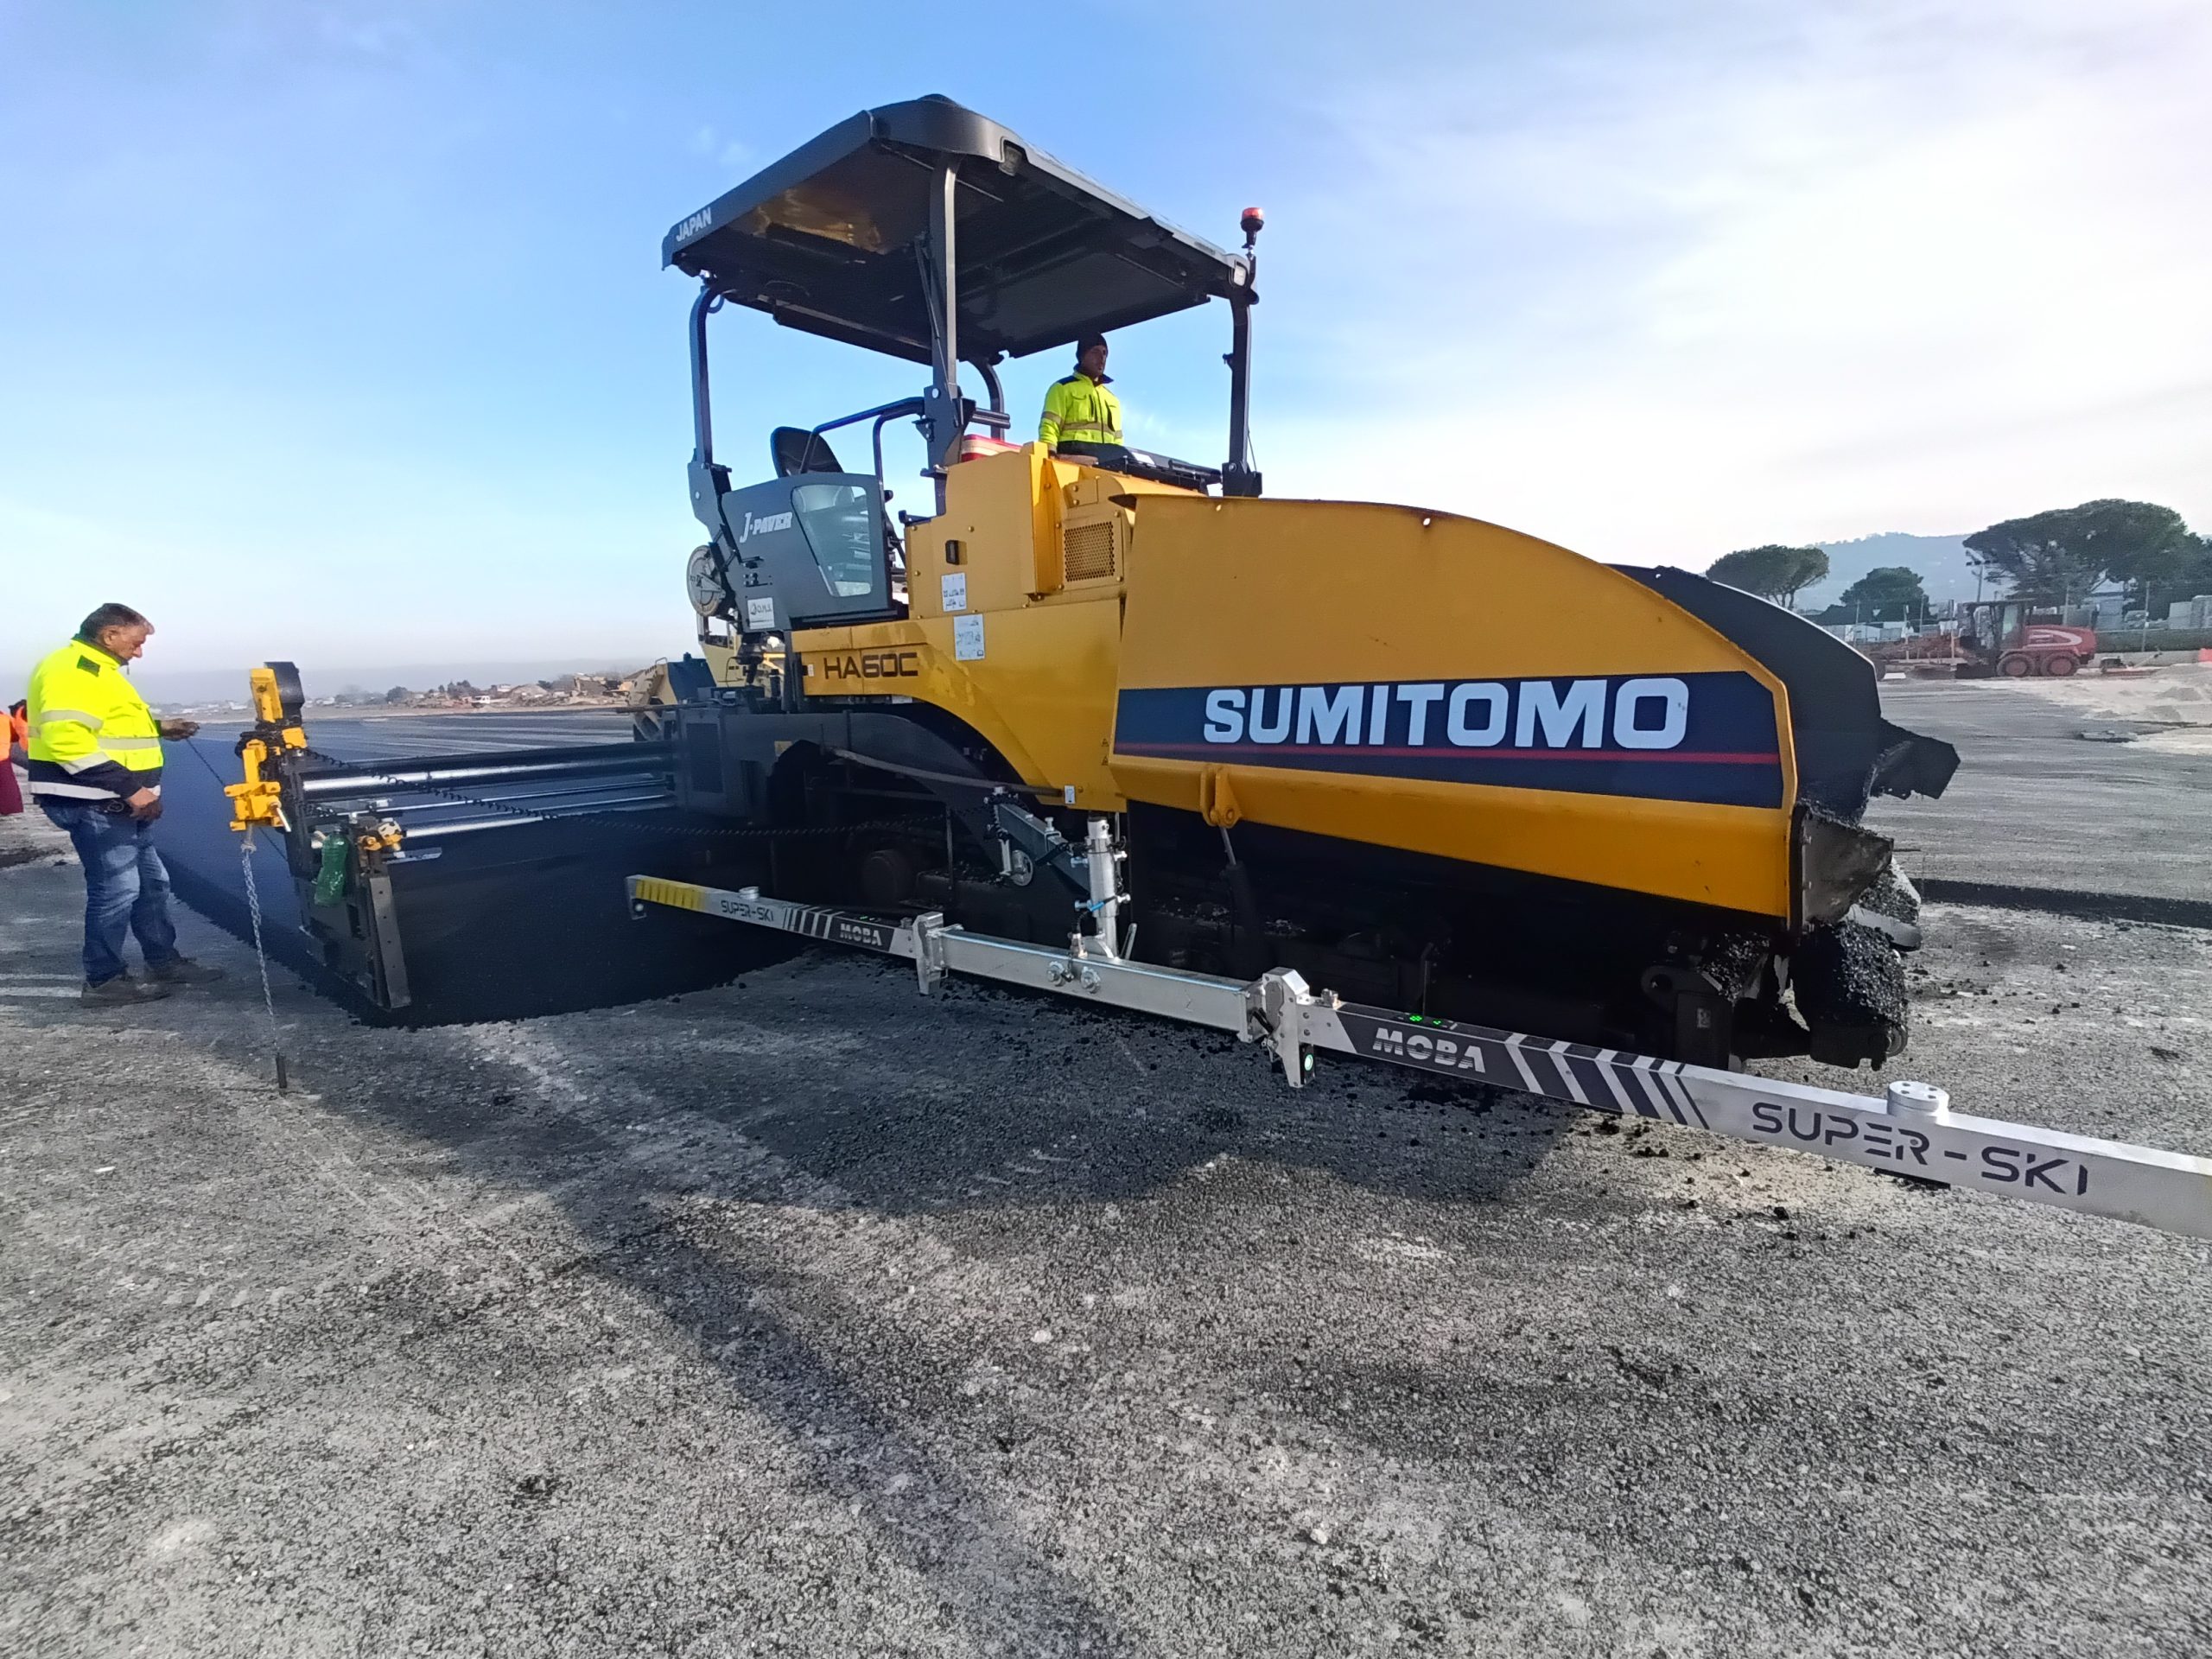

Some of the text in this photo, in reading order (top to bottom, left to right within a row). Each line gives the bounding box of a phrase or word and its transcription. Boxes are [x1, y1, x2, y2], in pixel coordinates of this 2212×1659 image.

[676, 207, 712, 242] JAPAN
[823, 652, 918, 680] HA60C
[1204, 677, 1689, 750] SUMITOMO
[721, 899, 774, 922] SUPER-SKI
[839, 923, 882, 946] MOBA
[1372, 1027, 1486, 1073] MOBA
